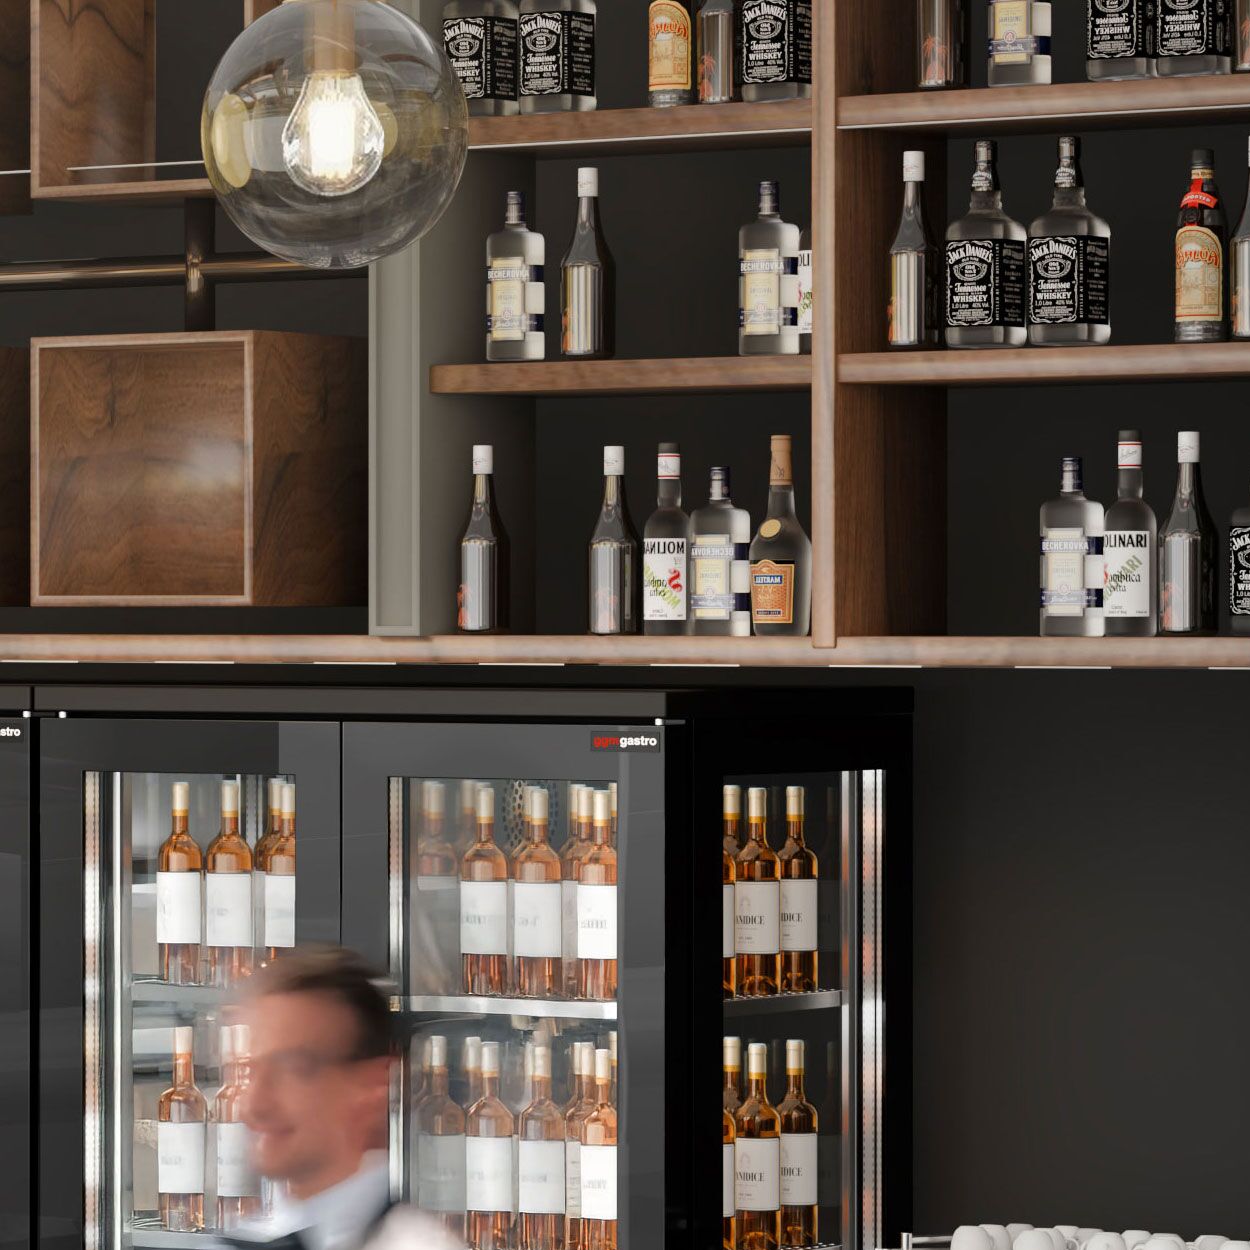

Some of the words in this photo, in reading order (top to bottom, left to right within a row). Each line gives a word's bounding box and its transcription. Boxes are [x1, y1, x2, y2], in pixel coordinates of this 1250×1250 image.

[744, 6, 760, 23] JACK
[444, 25, 460, 41] JACK
[520, 20, 536, 36] JACK
[748, 52, 782, 60] WHISKEY
[525, 64, 558, 72] WHISKEY
[948, 248, 966, 264] JACK
[1031, 244, 1049, 261] JACK
[953, 294, 988, 302] WHISKEY
[1036, 292, 1072, 300] WHISKEY
[1232, 534, 1250, 550] JACK
